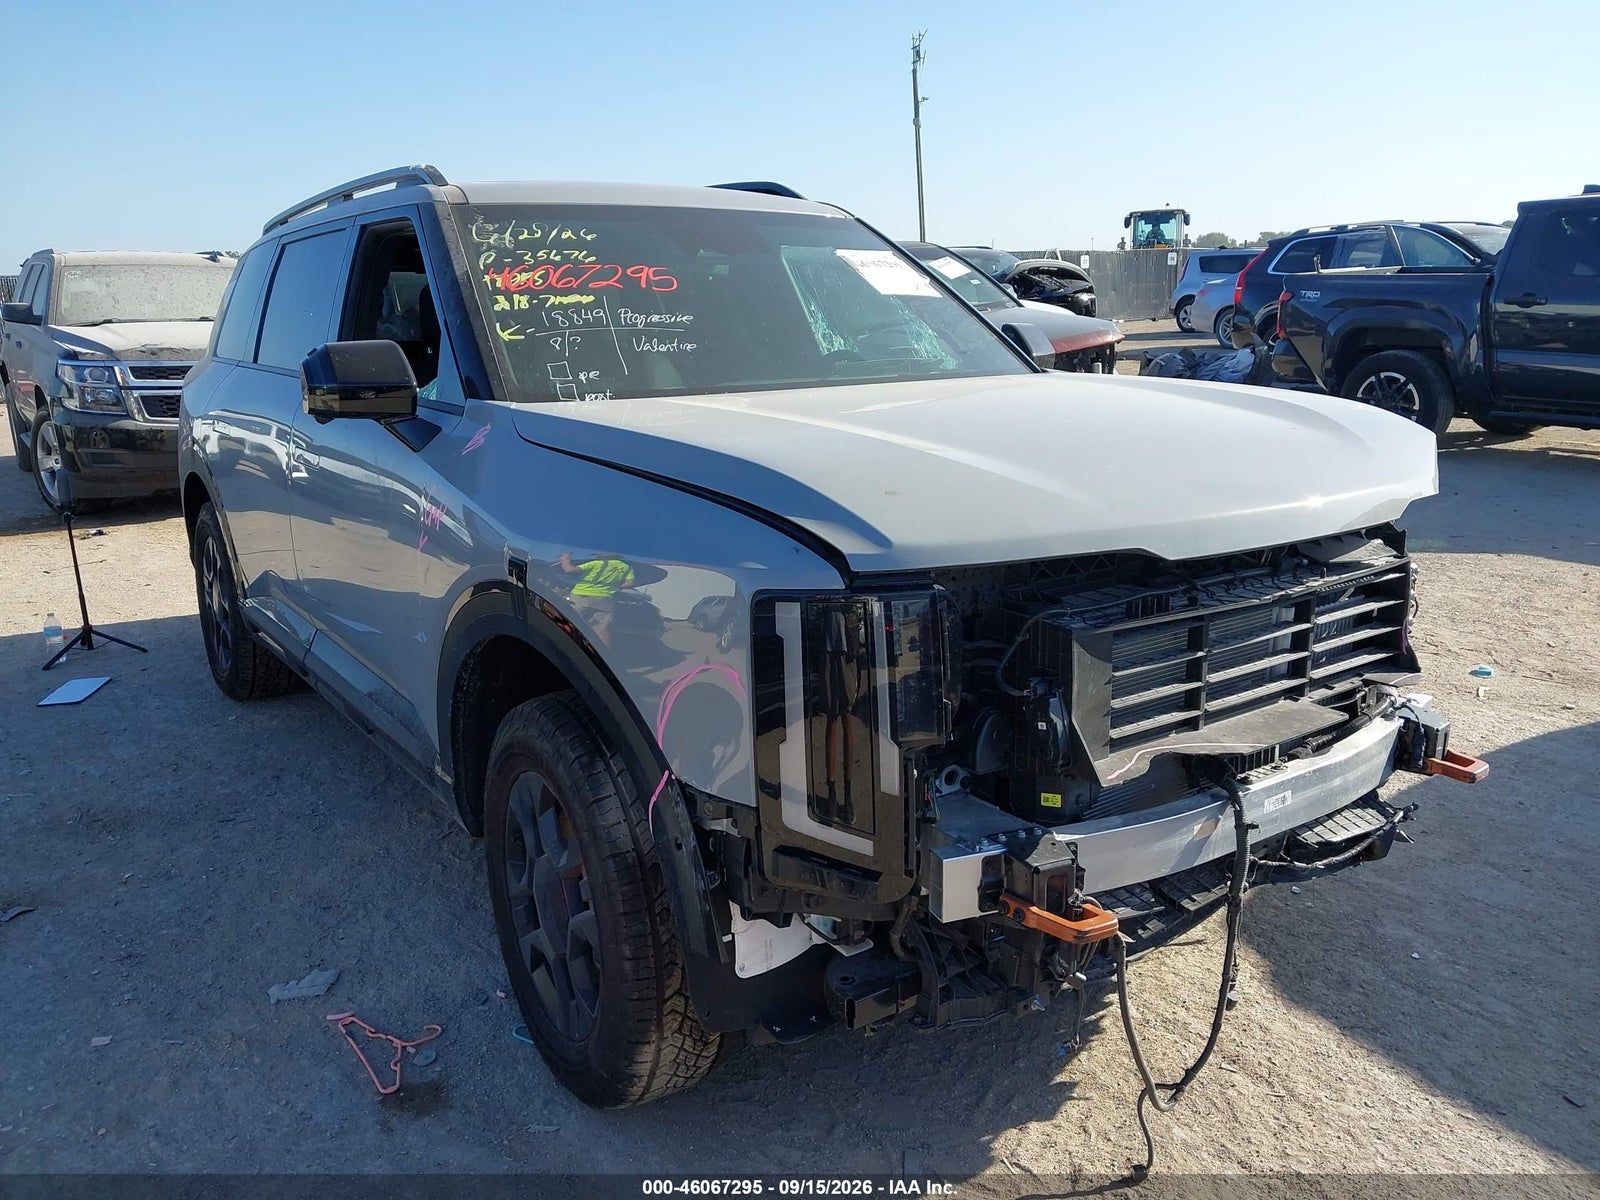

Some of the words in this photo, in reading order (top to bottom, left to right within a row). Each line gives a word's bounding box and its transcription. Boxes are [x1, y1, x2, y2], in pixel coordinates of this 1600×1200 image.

[541, 308, 606, 327] 18849
[617, 307, 695, 327] Progressive
[632, 335, 698, 353] Valentine
